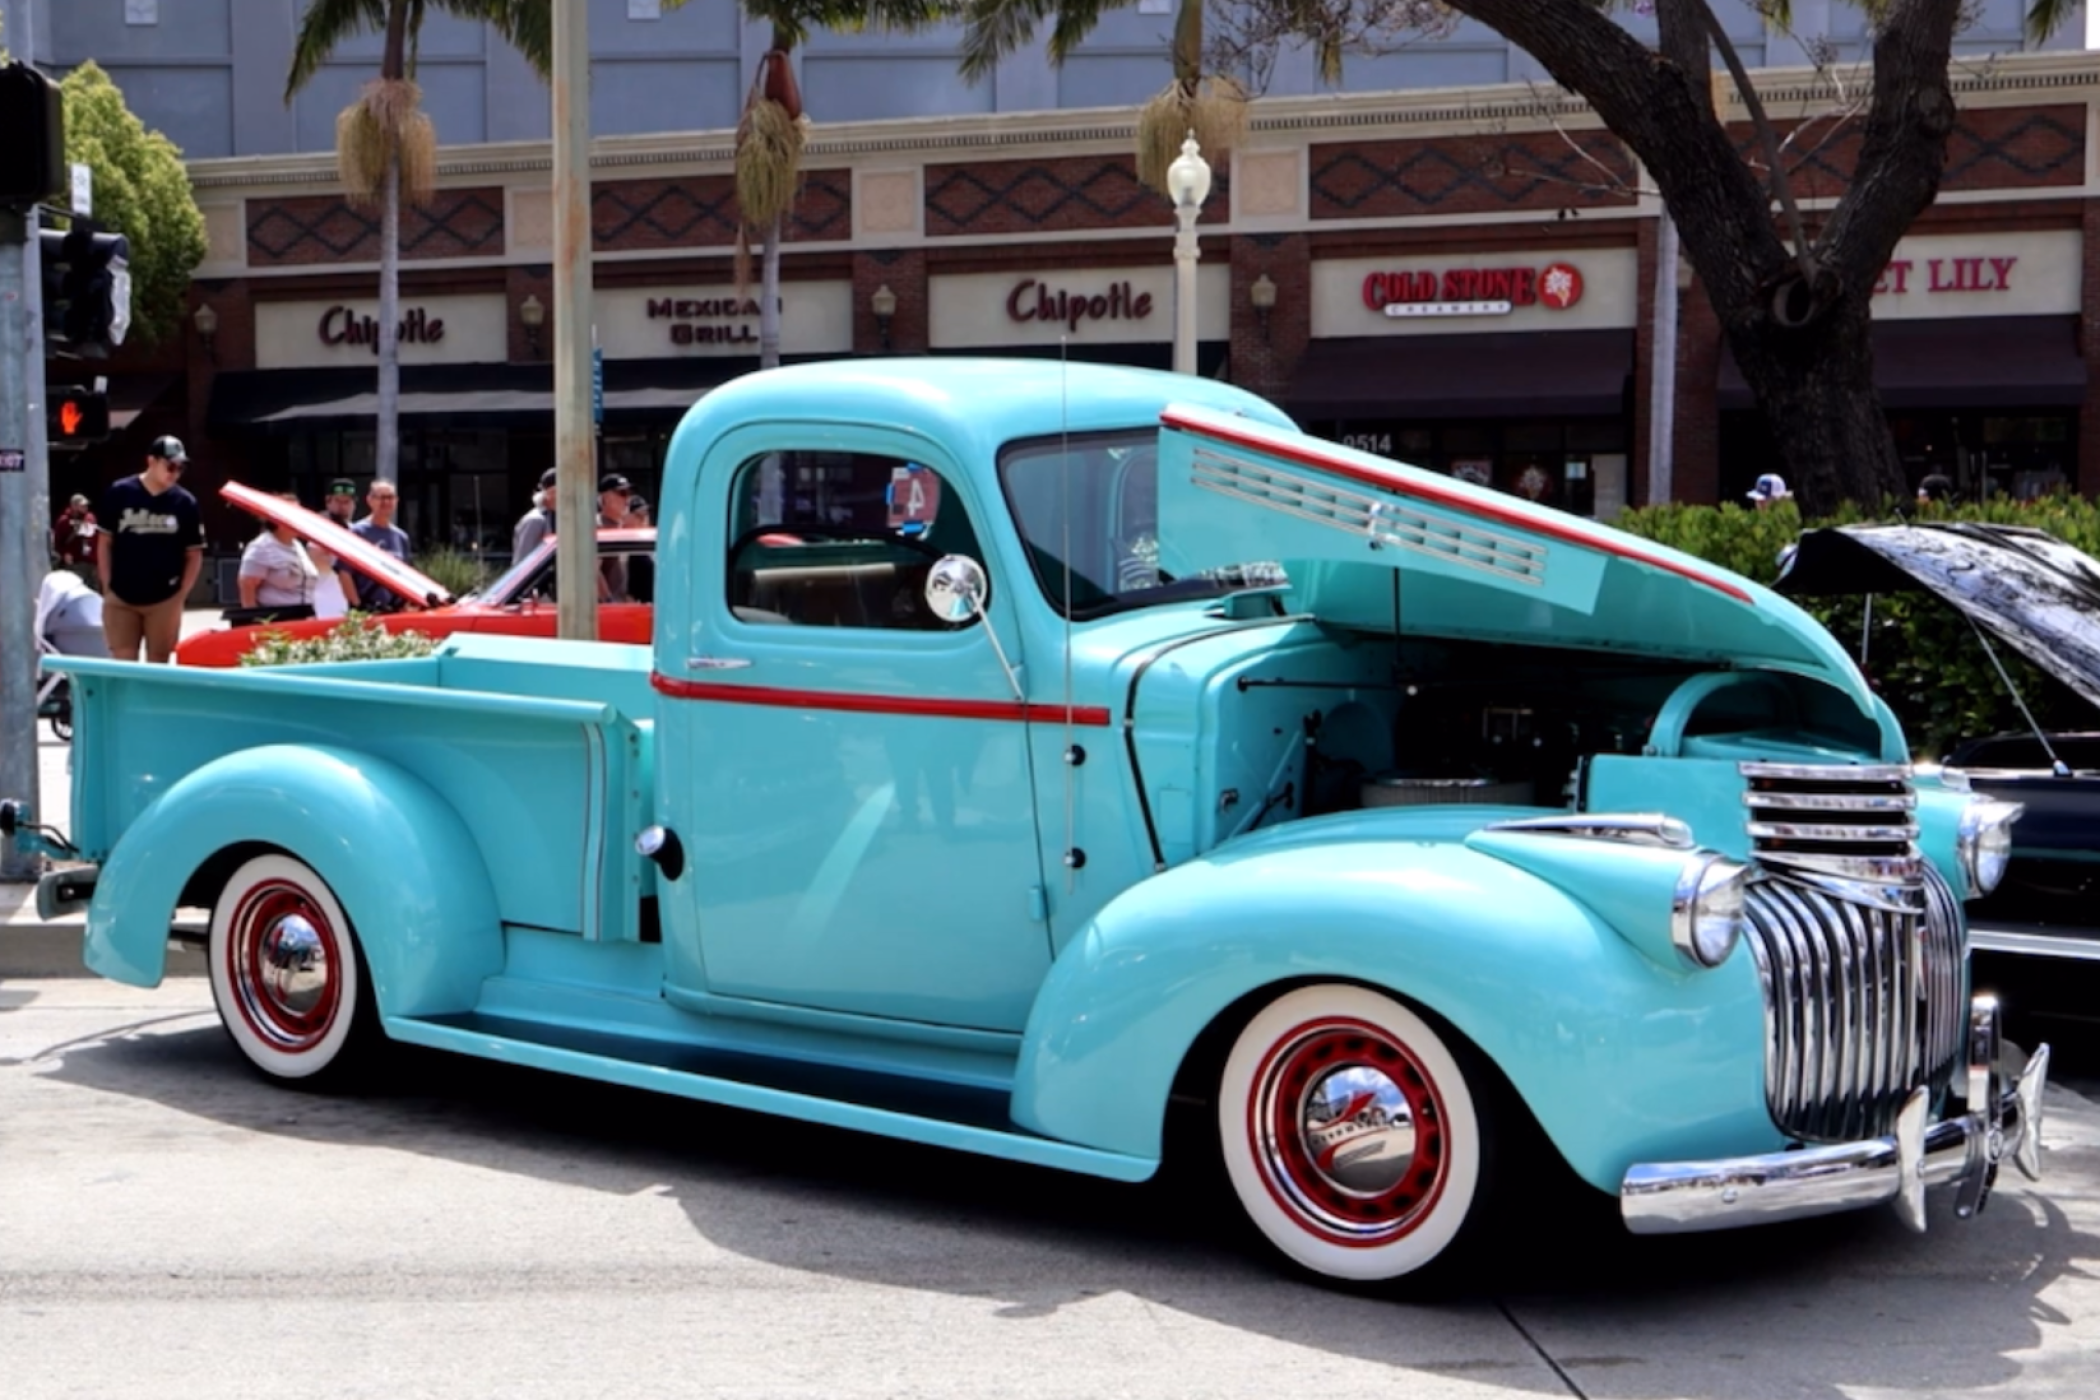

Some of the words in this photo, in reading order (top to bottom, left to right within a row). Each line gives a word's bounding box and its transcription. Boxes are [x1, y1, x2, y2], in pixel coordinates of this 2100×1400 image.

[1927, 256, 2019, 293] LILY
[1362, 269, 1437, 311] COLD
[1442, 267, 1536, 306] STONE
[647, 298, 782, 318] MEXICA
[1006, 278, 1153, 332] Chipotle
[1391, 303, 1506, 315] CREAMERY
[671, 324, 759, 344] GRILL
